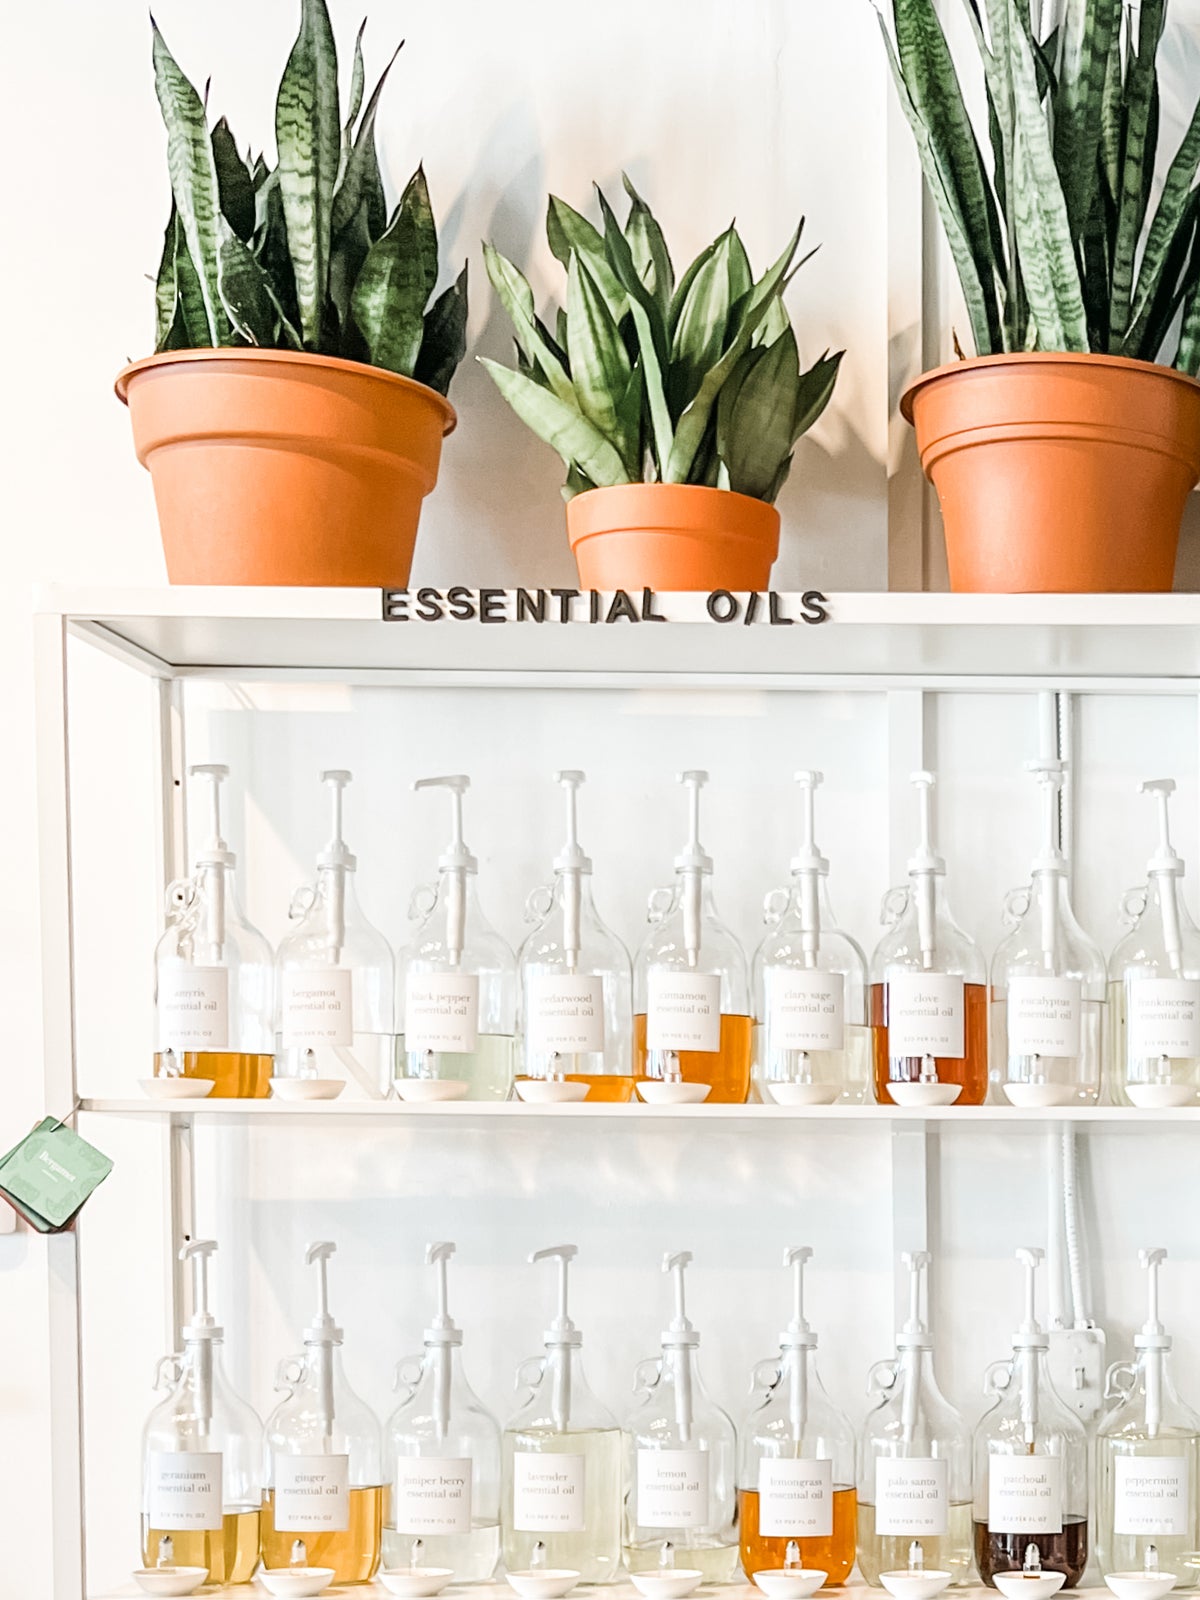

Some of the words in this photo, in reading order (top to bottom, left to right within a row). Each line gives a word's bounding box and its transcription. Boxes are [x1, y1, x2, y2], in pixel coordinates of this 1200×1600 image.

[381, 587, 667, 624] ESSENTIAL
[705, 588, 830, 626] OILS
[174, 988, 205, 999] amyris
[292, 989, 336, 999] bergamot
[411, 992, 433, 1001] black
[436, 994, 471, 1004] pepper
[540, 993, 592, 1003] cedarwood
[659, 992, 707, 1001] cinnamon
[784, 991, 806, 1001] clary
[809, 992, 831, 1001] sage
[913, 993, 939, 1003] clove
[166, 1001, 201, 1011] essential
[204, 1001, 217, 1011] oil
[289, 1001, 325, 1011] essential
[328, 1001, 341, 1011] oil
[1021, 996, 1070, 1008] eucalyptus
[1137, 997, 1195, 1007] frankincense
[414, 1006, 452, 1015] essential
[454, 1006, 467, 1015] oil
[539, 1006, 578, 1016] essential
[581, 1006, 594, 1016] oil
[656, 1004, 695, 1014] essential
[697, 1004, 710, 1015] oil
[781, 1004, 819, 1013] essential
[822, 1004, 835, 1014] oil
[899, 1007, 938, 1016] essential
[941, 1007, 953, 1016] oil
[1018, 1009, 1057, 1019] essential
[1060, 1010, 1072, 1020] oil
[1140, 1011, 1179, 1020] essential
[1181, 1011, 1193, 1020] oil
[160, 1470, 206, 1480] geranium
[294, 1472, 327, 1483] ginger
[528, 1472, 568, 1481] lavender
[657, 1468, 687, 1478] lemon
[404, 1476, 437, 1487] juniper
[439, 1476, 465, 1487] berry
[770, 1477, 823, 1488] lemongrass
[888, 1477, 908, 1488] palo
[910, 1478, 936, 1487] santo
[1003, 1474, 1047, 1486] patchouli
[1125, 1476, 1178, 1488] peppermint
[157, 1483, 196, 1493] essential
[198, 1483, 211, 1493] oil
[283, 1485, 322, 1495] essential
[325, 1485, 338, 1495] oil
[522, 1485, 559, 1495] essential
[562, 1485, 575, 1495] oil
[646, 1482, 684, 1491] essential
[686, 1482, 699, 1491] oil
[406, 1489, 446, 1498] essential
[448, 1489, 462, 1498] oil
[769, 1490, 808, 1500] essential
[811, 1490, 823, 1500] oil
[885, 1489, 924, 1499] essential
[926, 1489, 938, 1499] oil
[999, 1487, 1037, 1497] essential
[1040, 1487, 1052, 1497] oil
[1126, 1489, 1164, 1498] essential
[1166, 1489, 1178, 1498] oil
